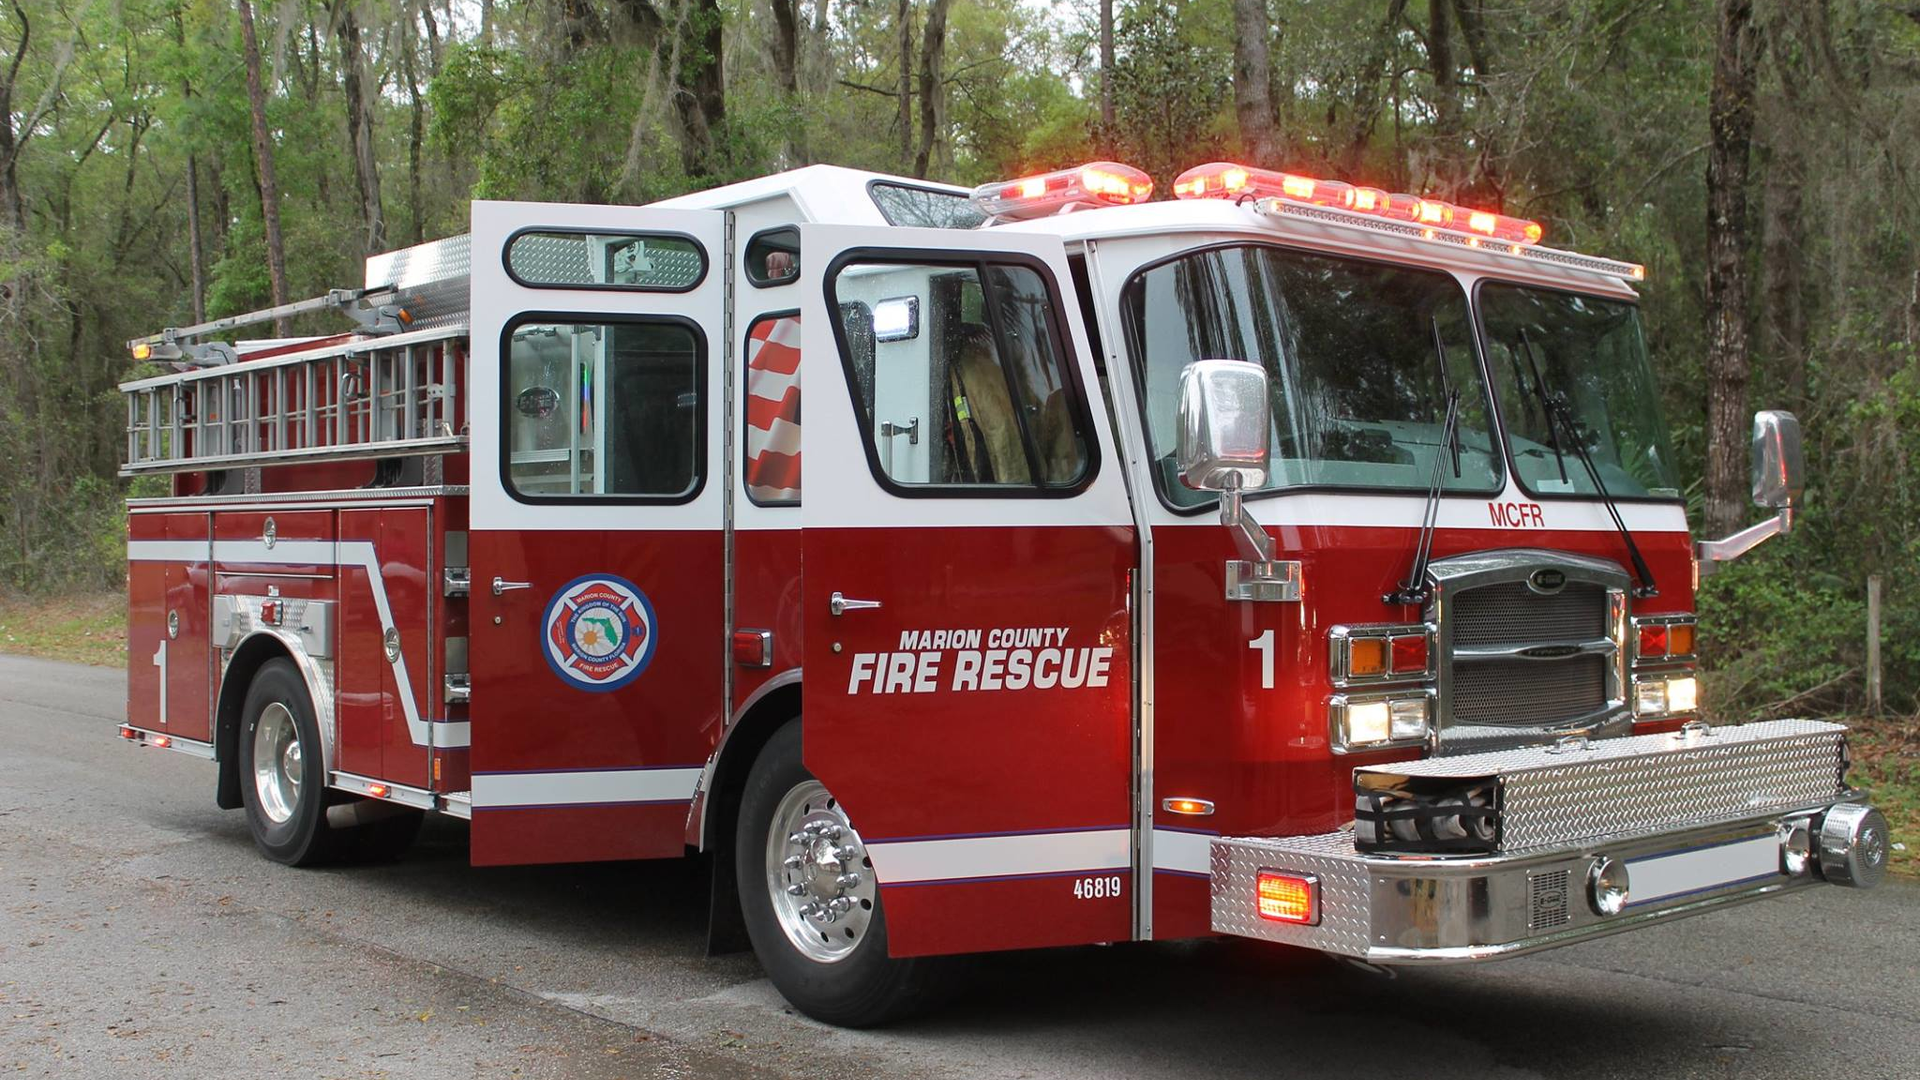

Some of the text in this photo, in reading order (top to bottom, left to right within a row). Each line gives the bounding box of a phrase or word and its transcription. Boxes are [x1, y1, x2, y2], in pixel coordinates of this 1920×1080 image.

[1488, 502, 1545, 527] MCFR
[576, 592, 622, 603] MARION COUNTY
[899, 628, 1070, 651] MARION COUNTY
[579, 663, 619, 672] FIRE RESCUE
[848, 647, 1113, 695] FIRE RESCUE
[1249, 629, 1274, 689] 1
[153, 640, 167, 724] 1
[1074, 876, 1121, 900] 46819
